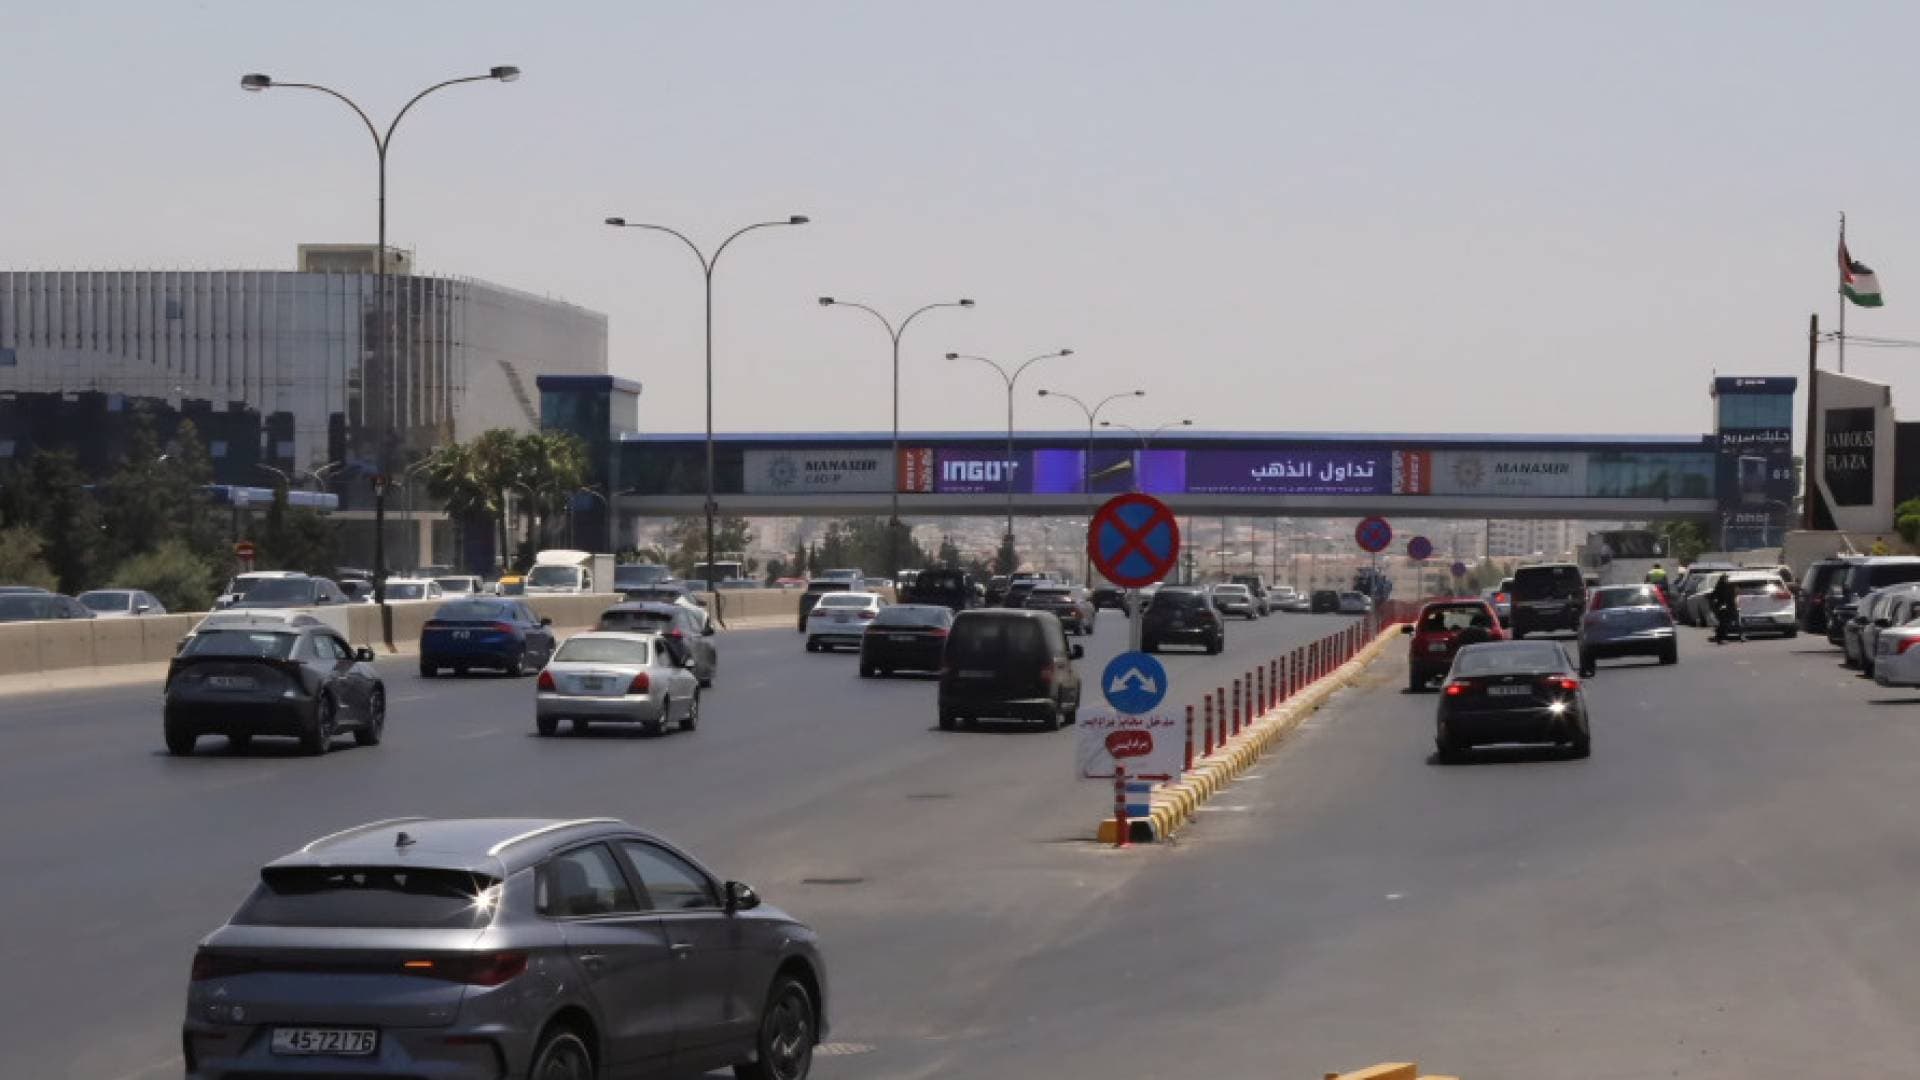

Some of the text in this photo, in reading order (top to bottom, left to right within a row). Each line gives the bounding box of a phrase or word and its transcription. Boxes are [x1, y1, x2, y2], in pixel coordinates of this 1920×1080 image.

[943, 460, 1018, 481] INGOT
[1251, 460, 1313, 482] الذهب
[1320, 460, 1376, 482] تداول
[288, 1030, 373, 1050] 45-72176
